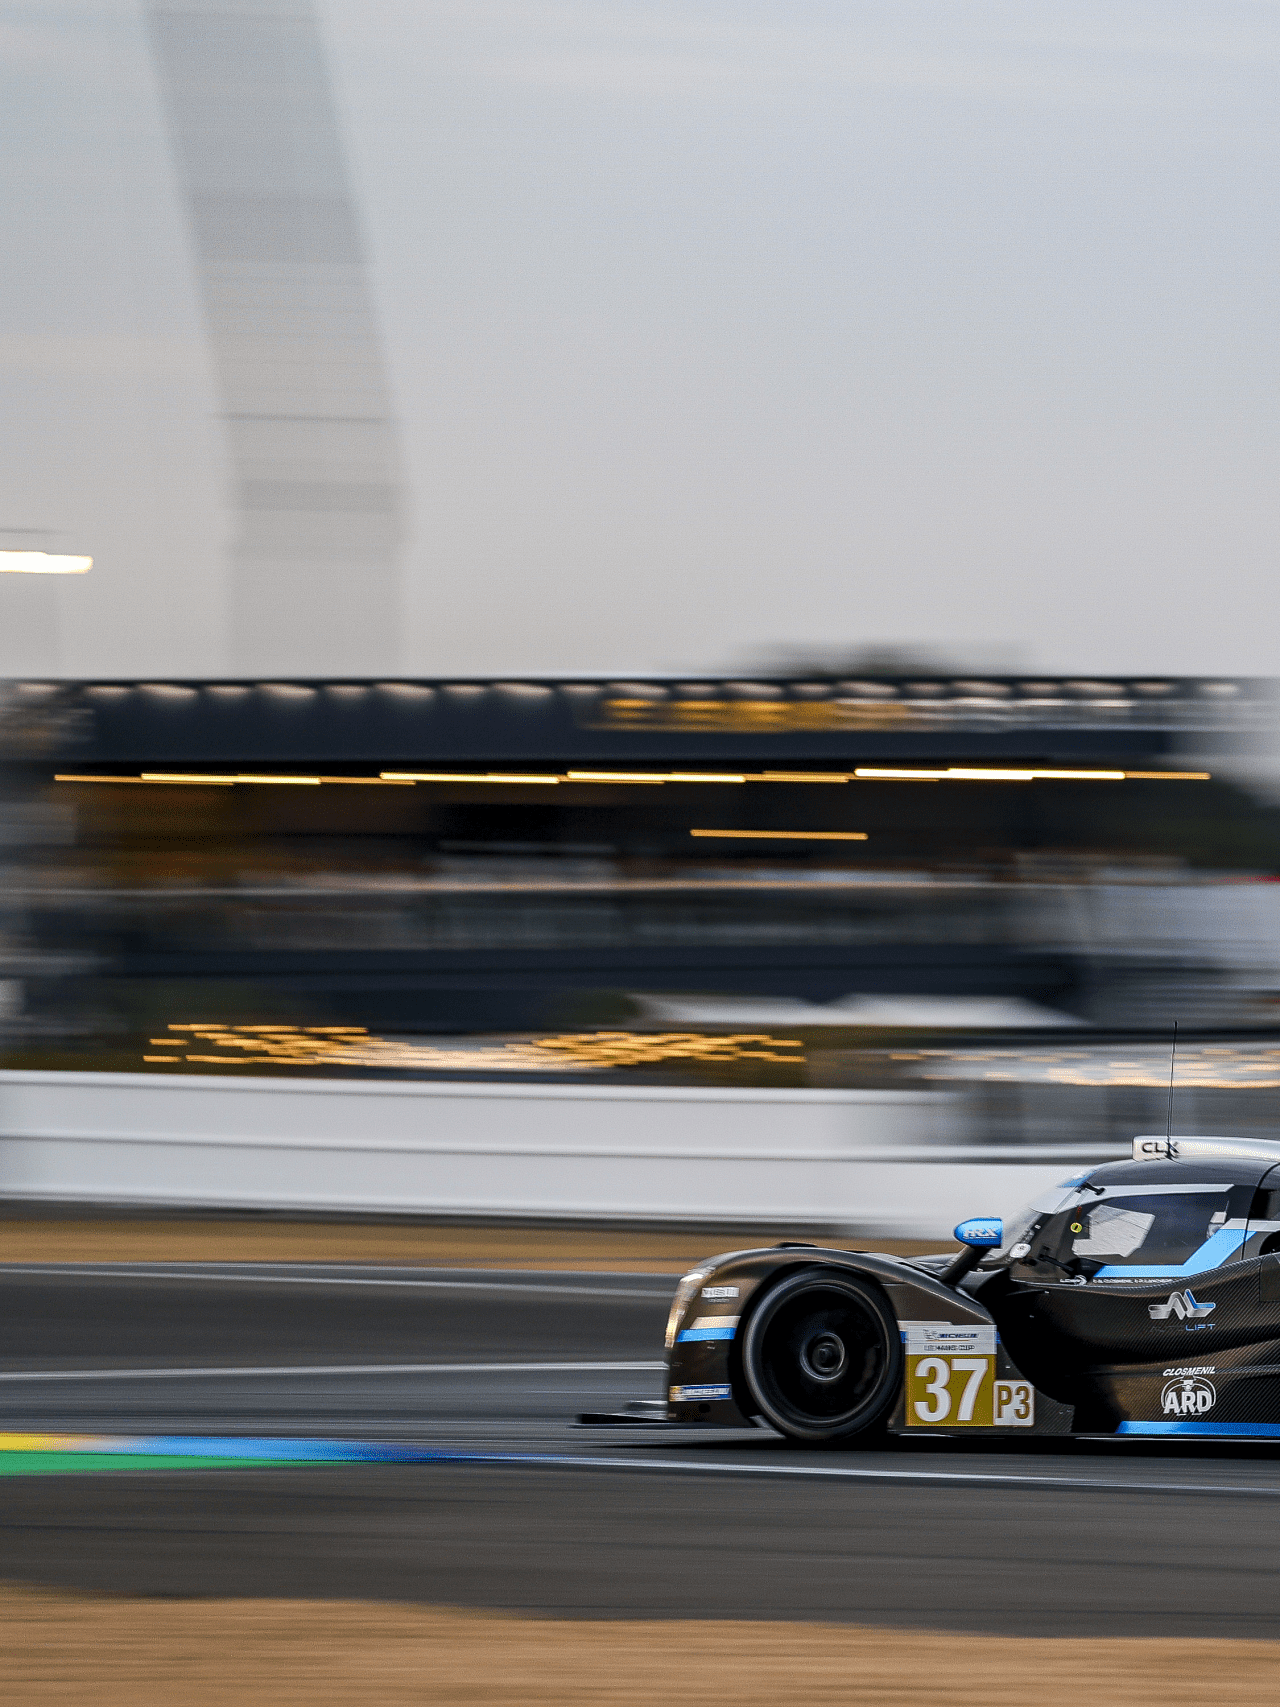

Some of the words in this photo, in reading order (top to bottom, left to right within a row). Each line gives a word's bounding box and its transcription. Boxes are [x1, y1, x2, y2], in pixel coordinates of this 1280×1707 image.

[1142, 1141, 1179, 1153] CLX
[1162, 1366, 1216, 1377] CLOSMENIL
[914, 1357, 989, 1422] 37
[996, 1385, 1031, 1420] P3
[1163, 1391, 1213, 1414] ARD
